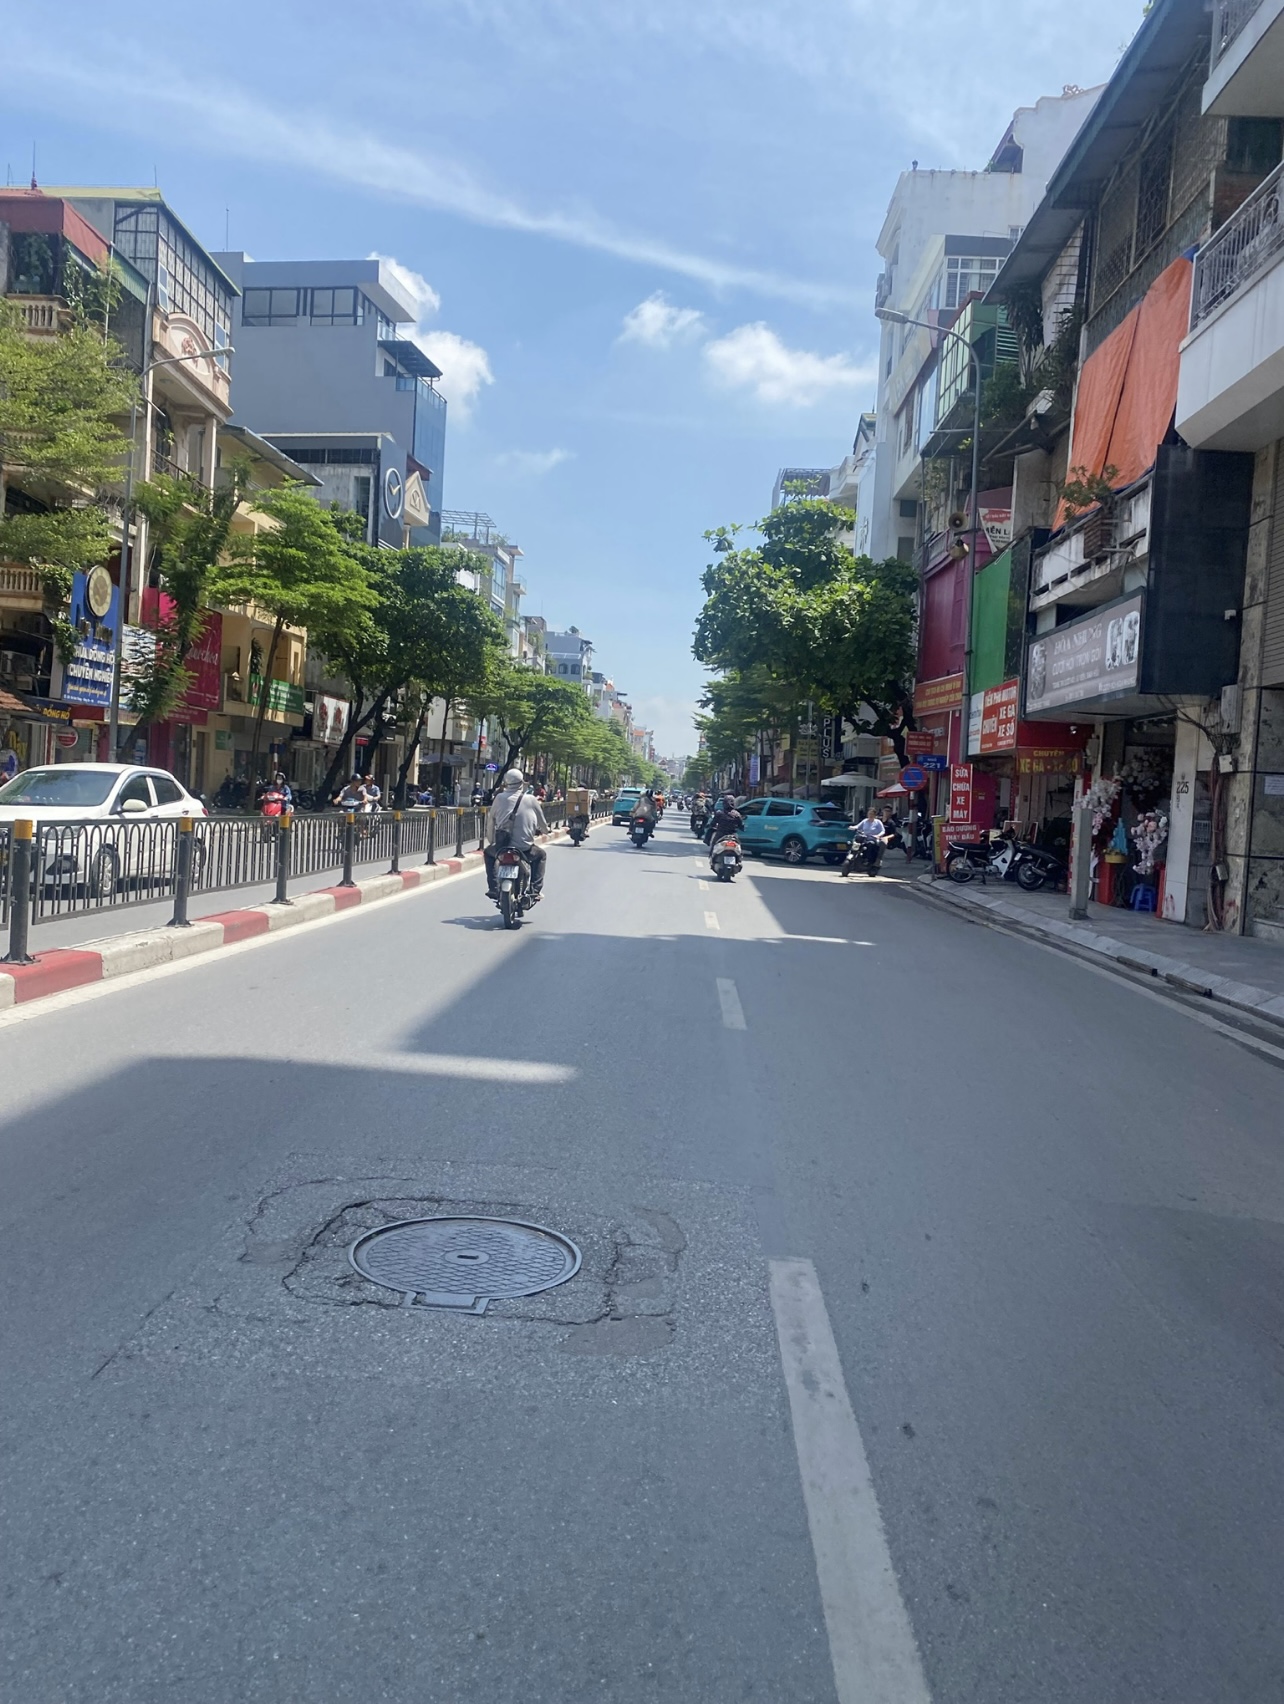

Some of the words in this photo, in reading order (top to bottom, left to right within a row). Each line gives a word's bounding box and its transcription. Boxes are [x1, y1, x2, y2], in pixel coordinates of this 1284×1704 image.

[61, 707, 71, 719] HỒ
[999, 706, 1006, 720] XE
[998, 724, 1006, 738] XE
[1006, 717, 1015, 737] SỐ
[1020, 758, 1031, 773] XE
[955, 767, 969, 778] SỬA
[952, 782, 970, 792] CHỮA
[1176, 781, 1189, 794] 225
[956, 796, 966, 805] XE
[953, 809, 968, 819] MÁY
